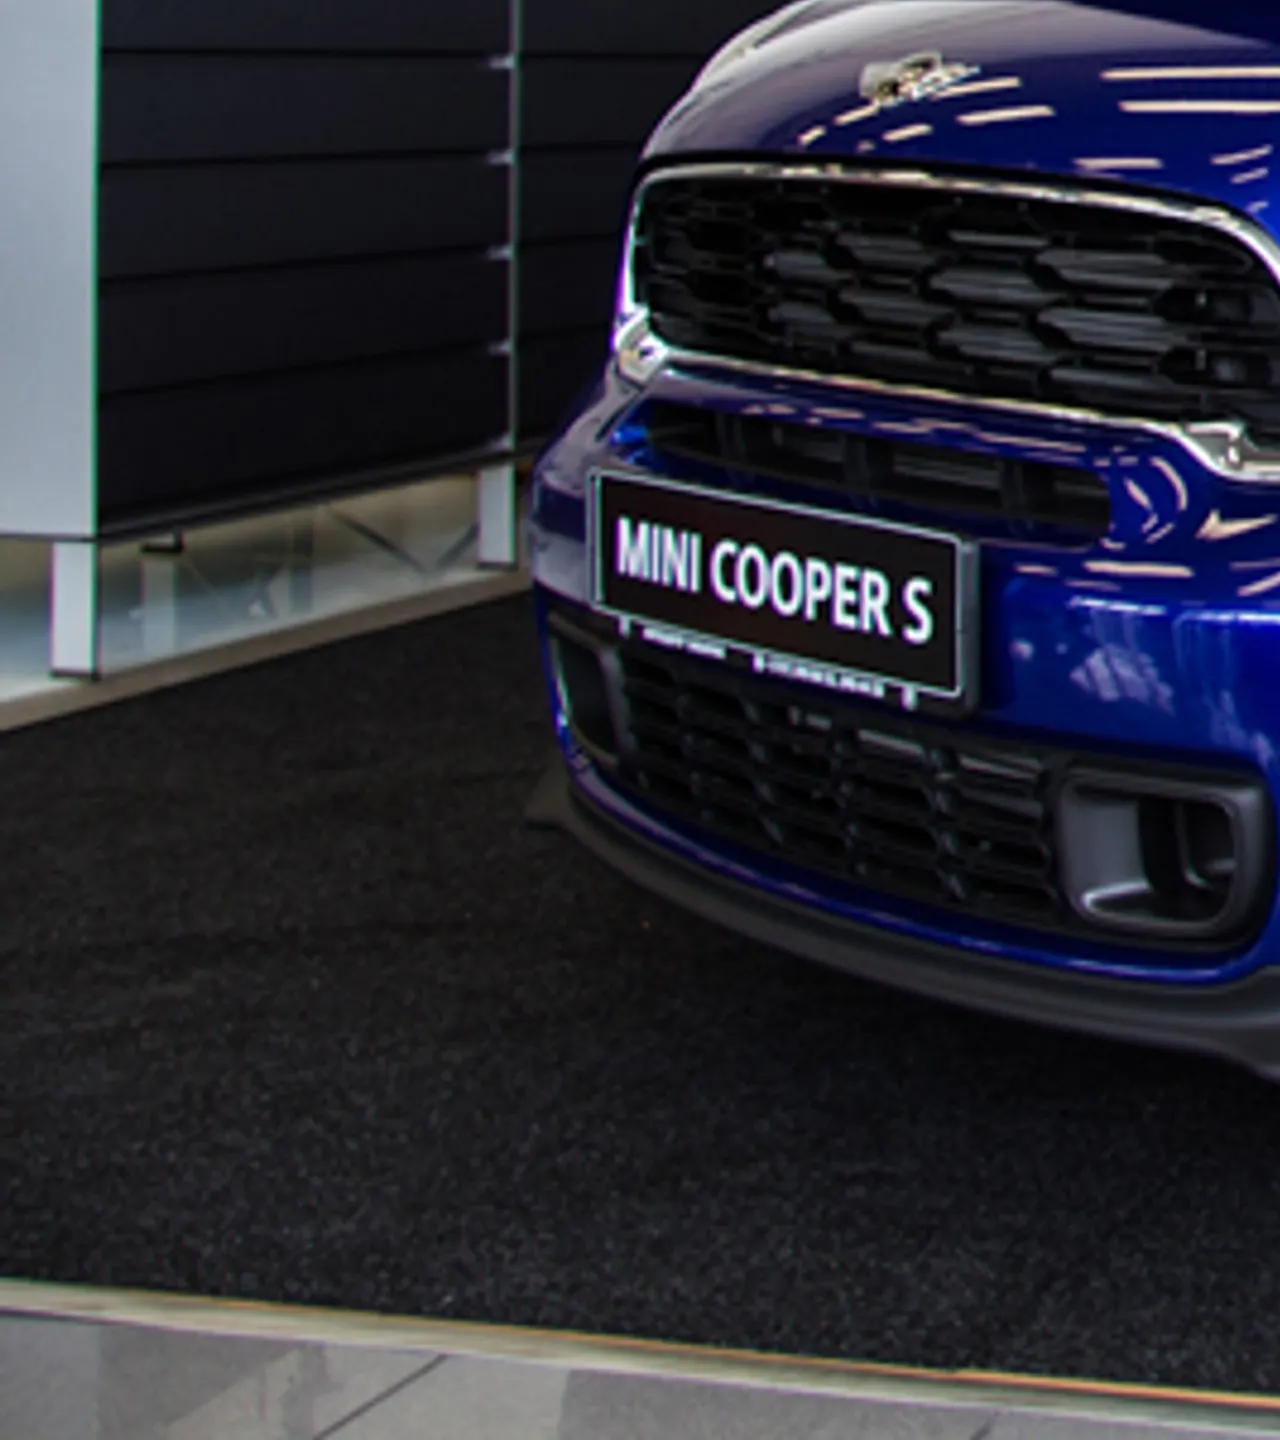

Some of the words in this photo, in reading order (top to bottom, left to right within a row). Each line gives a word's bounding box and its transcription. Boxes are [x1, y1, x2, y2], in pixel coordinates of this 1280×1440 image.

[617, 516, 700, 593] MINI
[710, 538, 892, 637] COOPER
[902, 576, 933, 644] S
